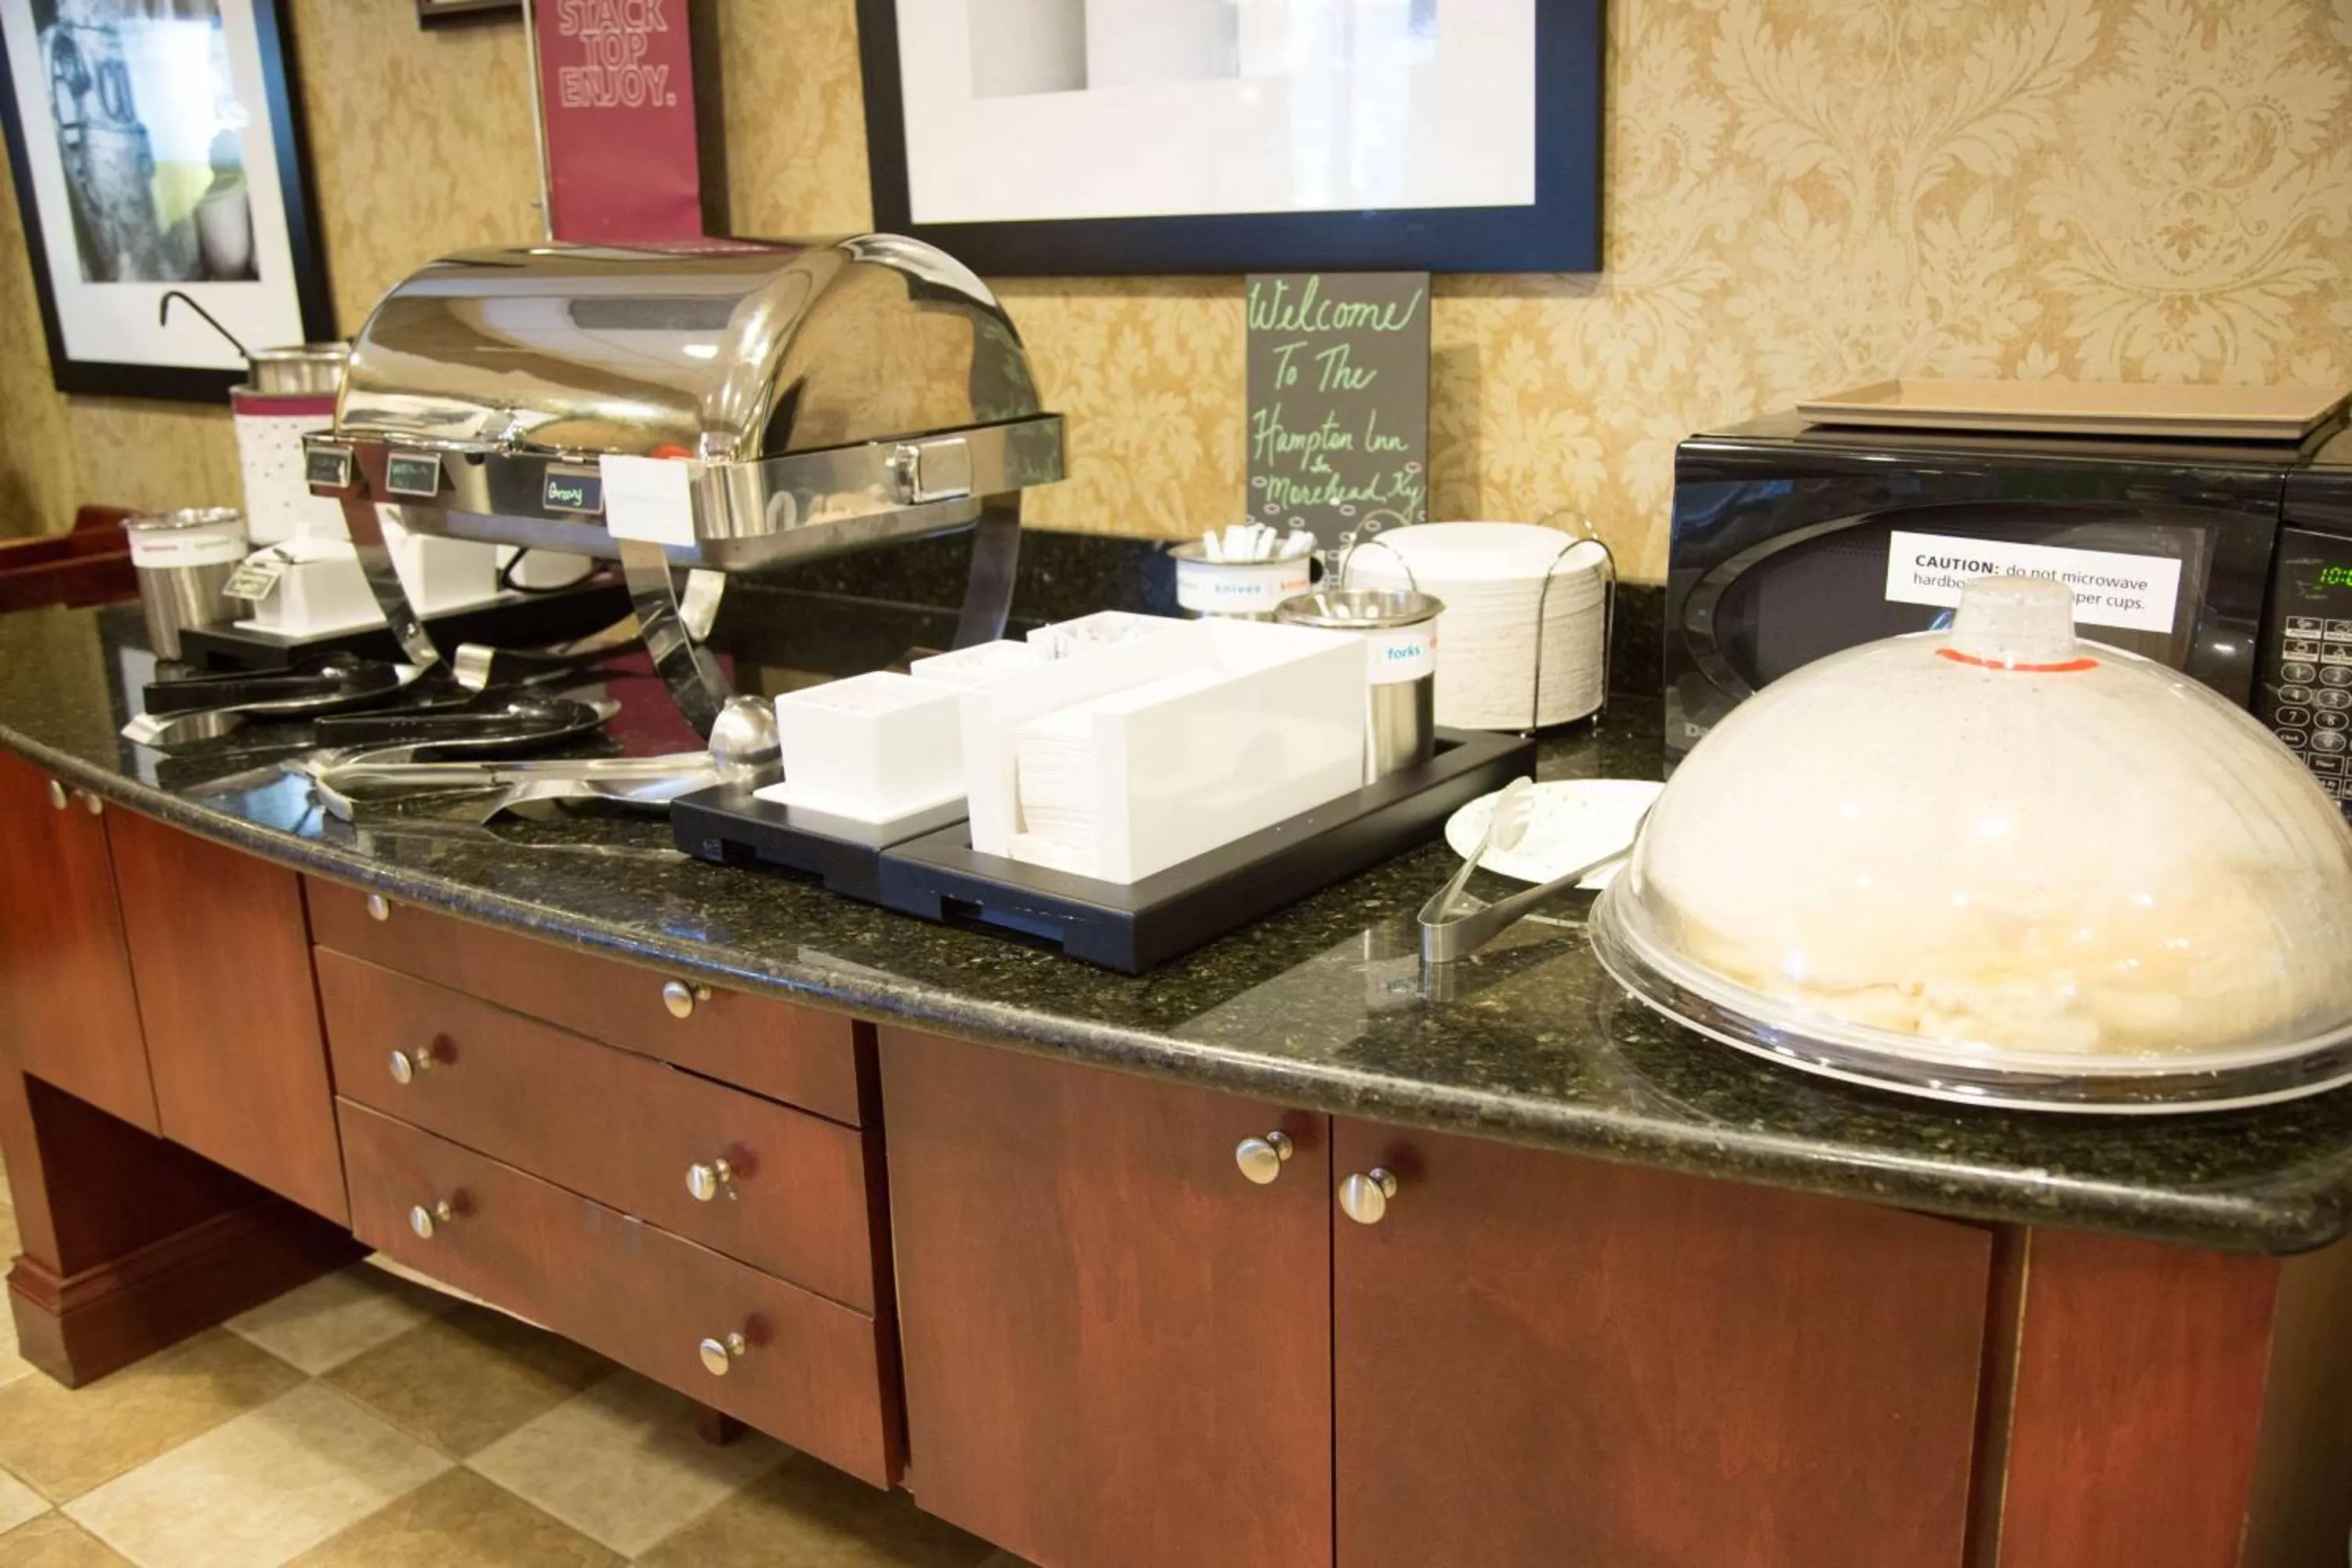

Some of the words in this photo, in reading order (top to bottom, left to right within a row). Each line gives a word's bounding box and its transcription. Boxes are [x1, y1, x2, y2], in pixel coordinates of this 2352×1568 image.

[557, 0, 668, 36] STACK
[579, 28, 648, 71] TOP
[558, 64, 677, 107] ENJOY.
[1249, 274, 1423, 332] Welcome
[1272, 340, 1308, 390] To
[1315, 343, 1377, 392] The
[1252, 401, 1354, 471] Hampton
[1364, 408, 1409, 453] Inn
[548, 481, 582, 506] Gravy
[1914, 572, 1969, 590] hardbo
[2072, 592, 2102, 606] per
[2107, 596, 2145, 611] cups.
[1915, 554, 1999, 575] CAUTION:
[2006, 564, 2026, 577] do
[2031, 568, 2057, 582] not
[2062, 571, 2148, 591] microwave
[1387, 644, 1421, 660] forks
[2288, 711, 2297, 722] 7
